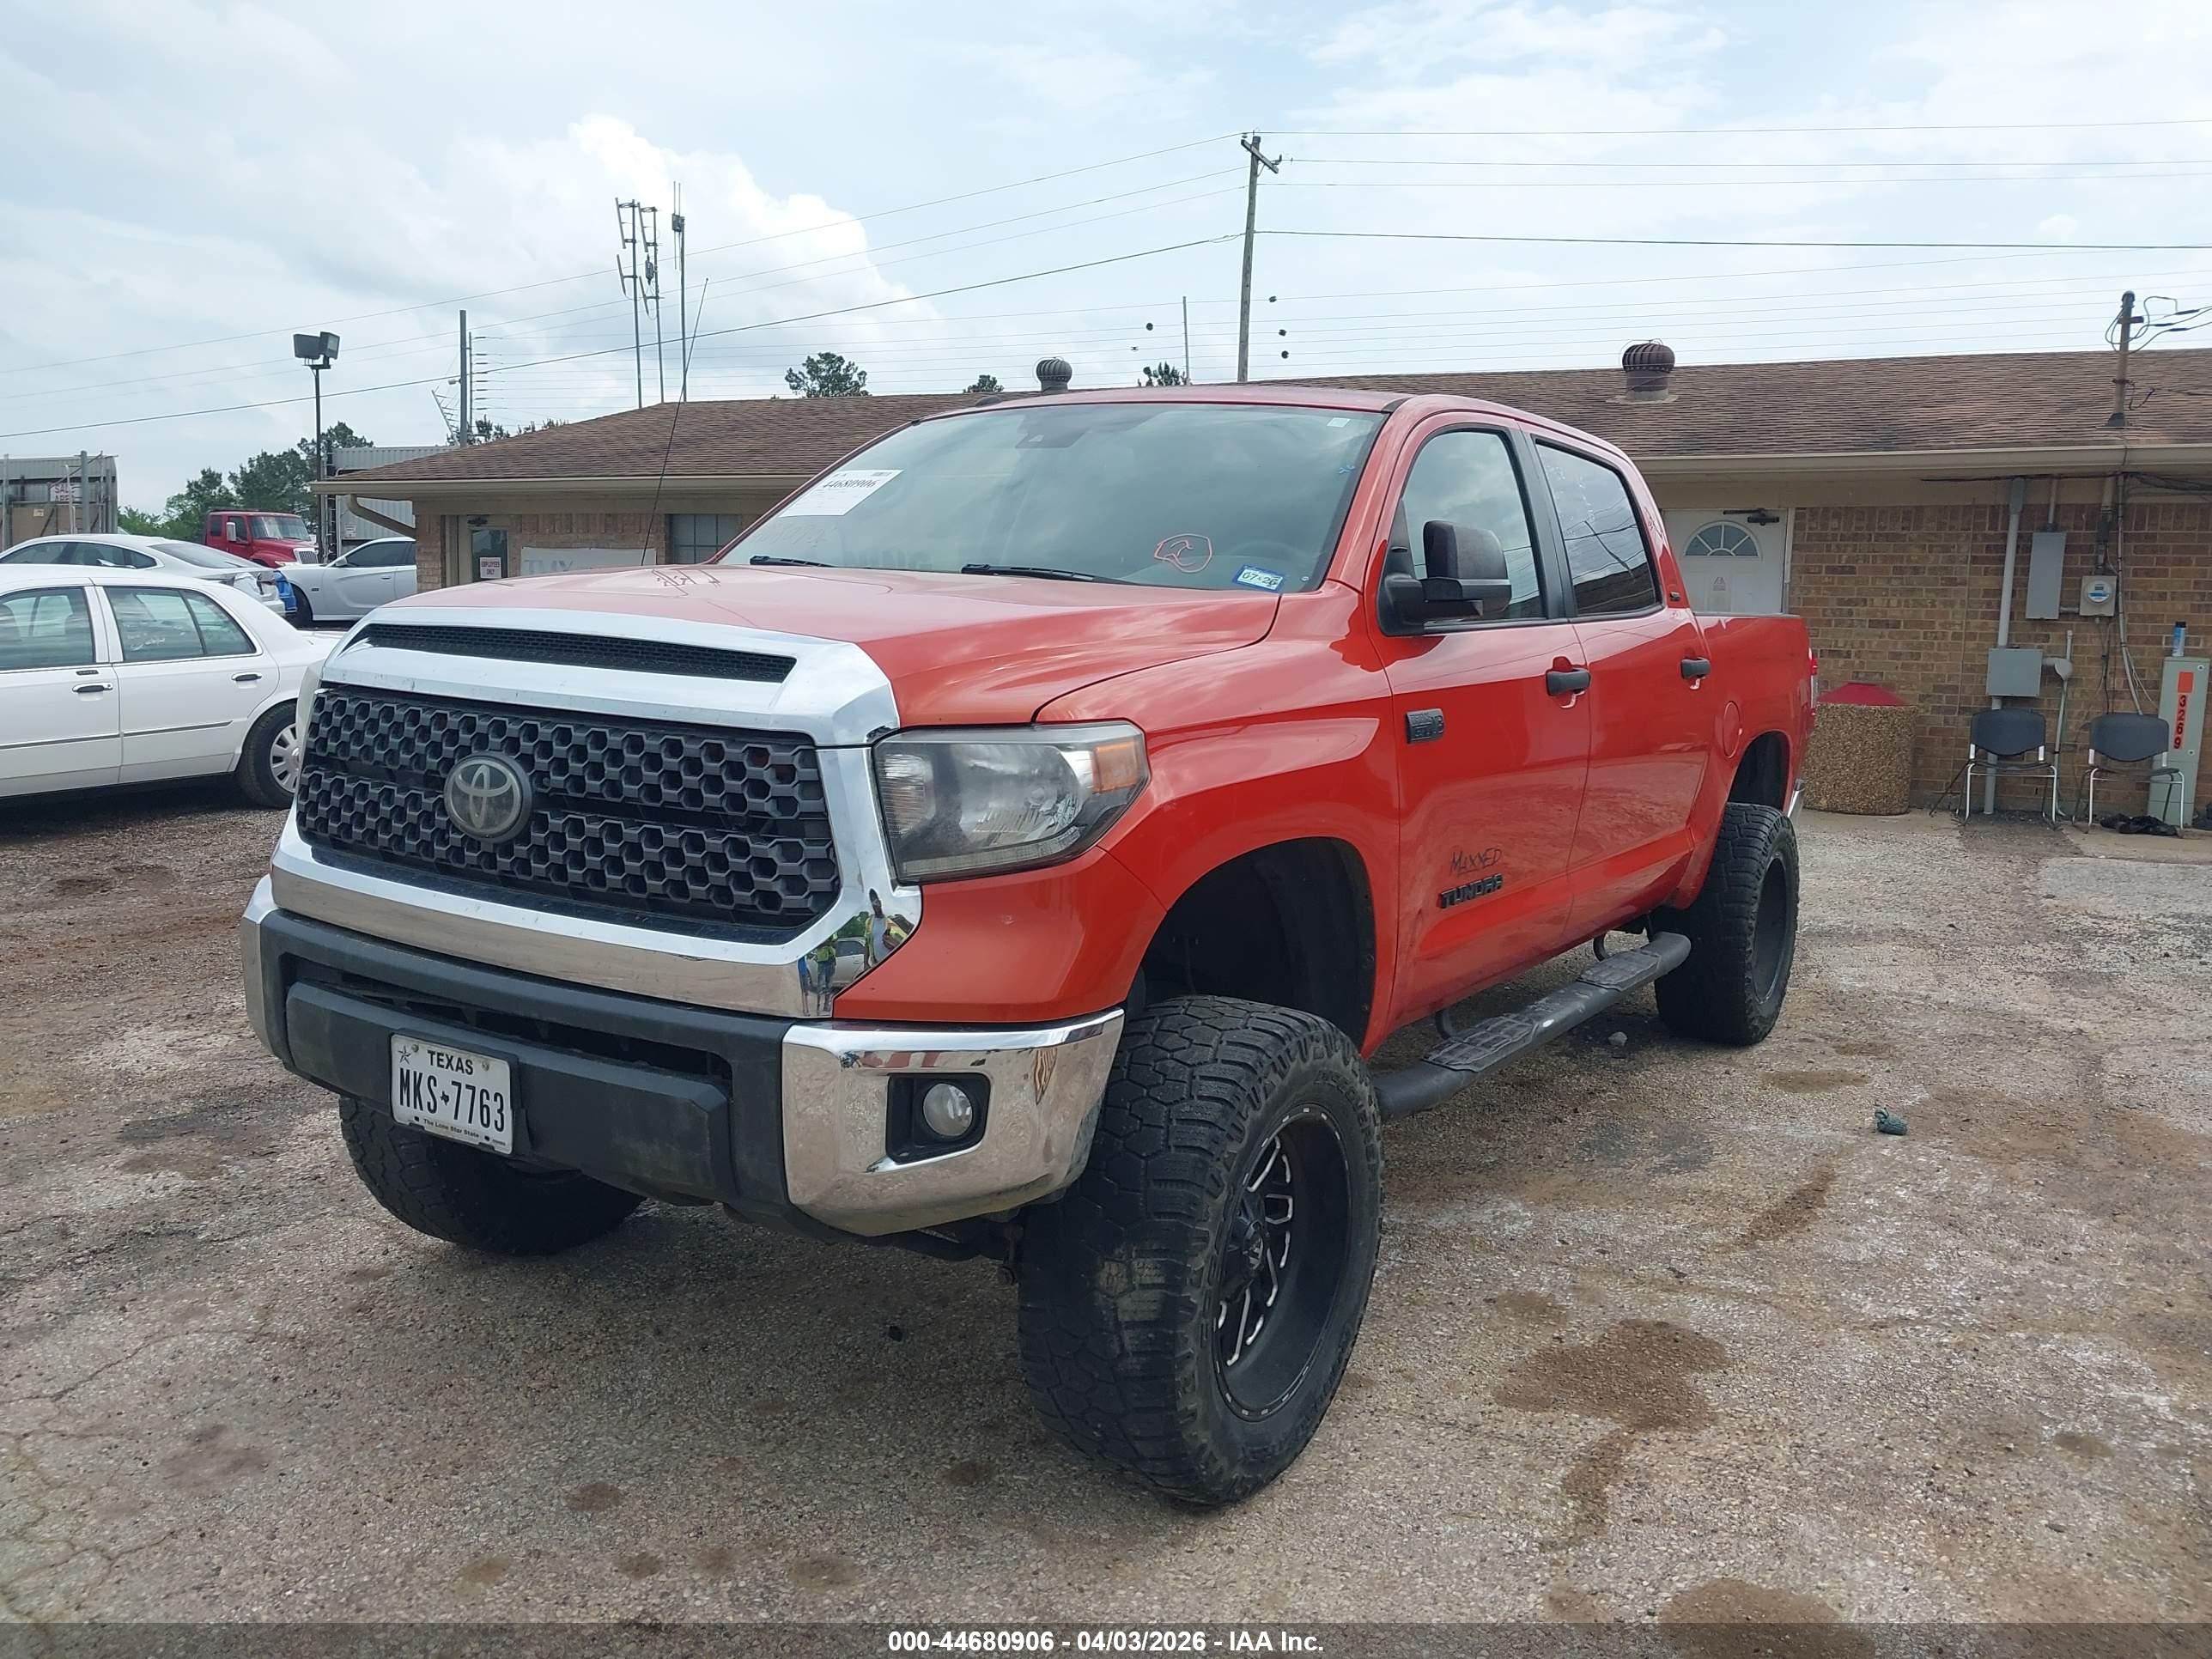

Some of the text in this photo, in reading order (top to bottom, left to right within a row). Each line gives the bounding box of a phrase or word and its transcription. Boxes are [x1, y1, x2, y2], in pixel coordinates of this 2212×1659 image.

[1439, 872, 1504, 908] TUNDRA
[427, 1049, 474, 1075] TEXAS
[399, 1067, 505, 1133] MKS 7763
[423, 1118, 480, 1138] The Lone Star State
